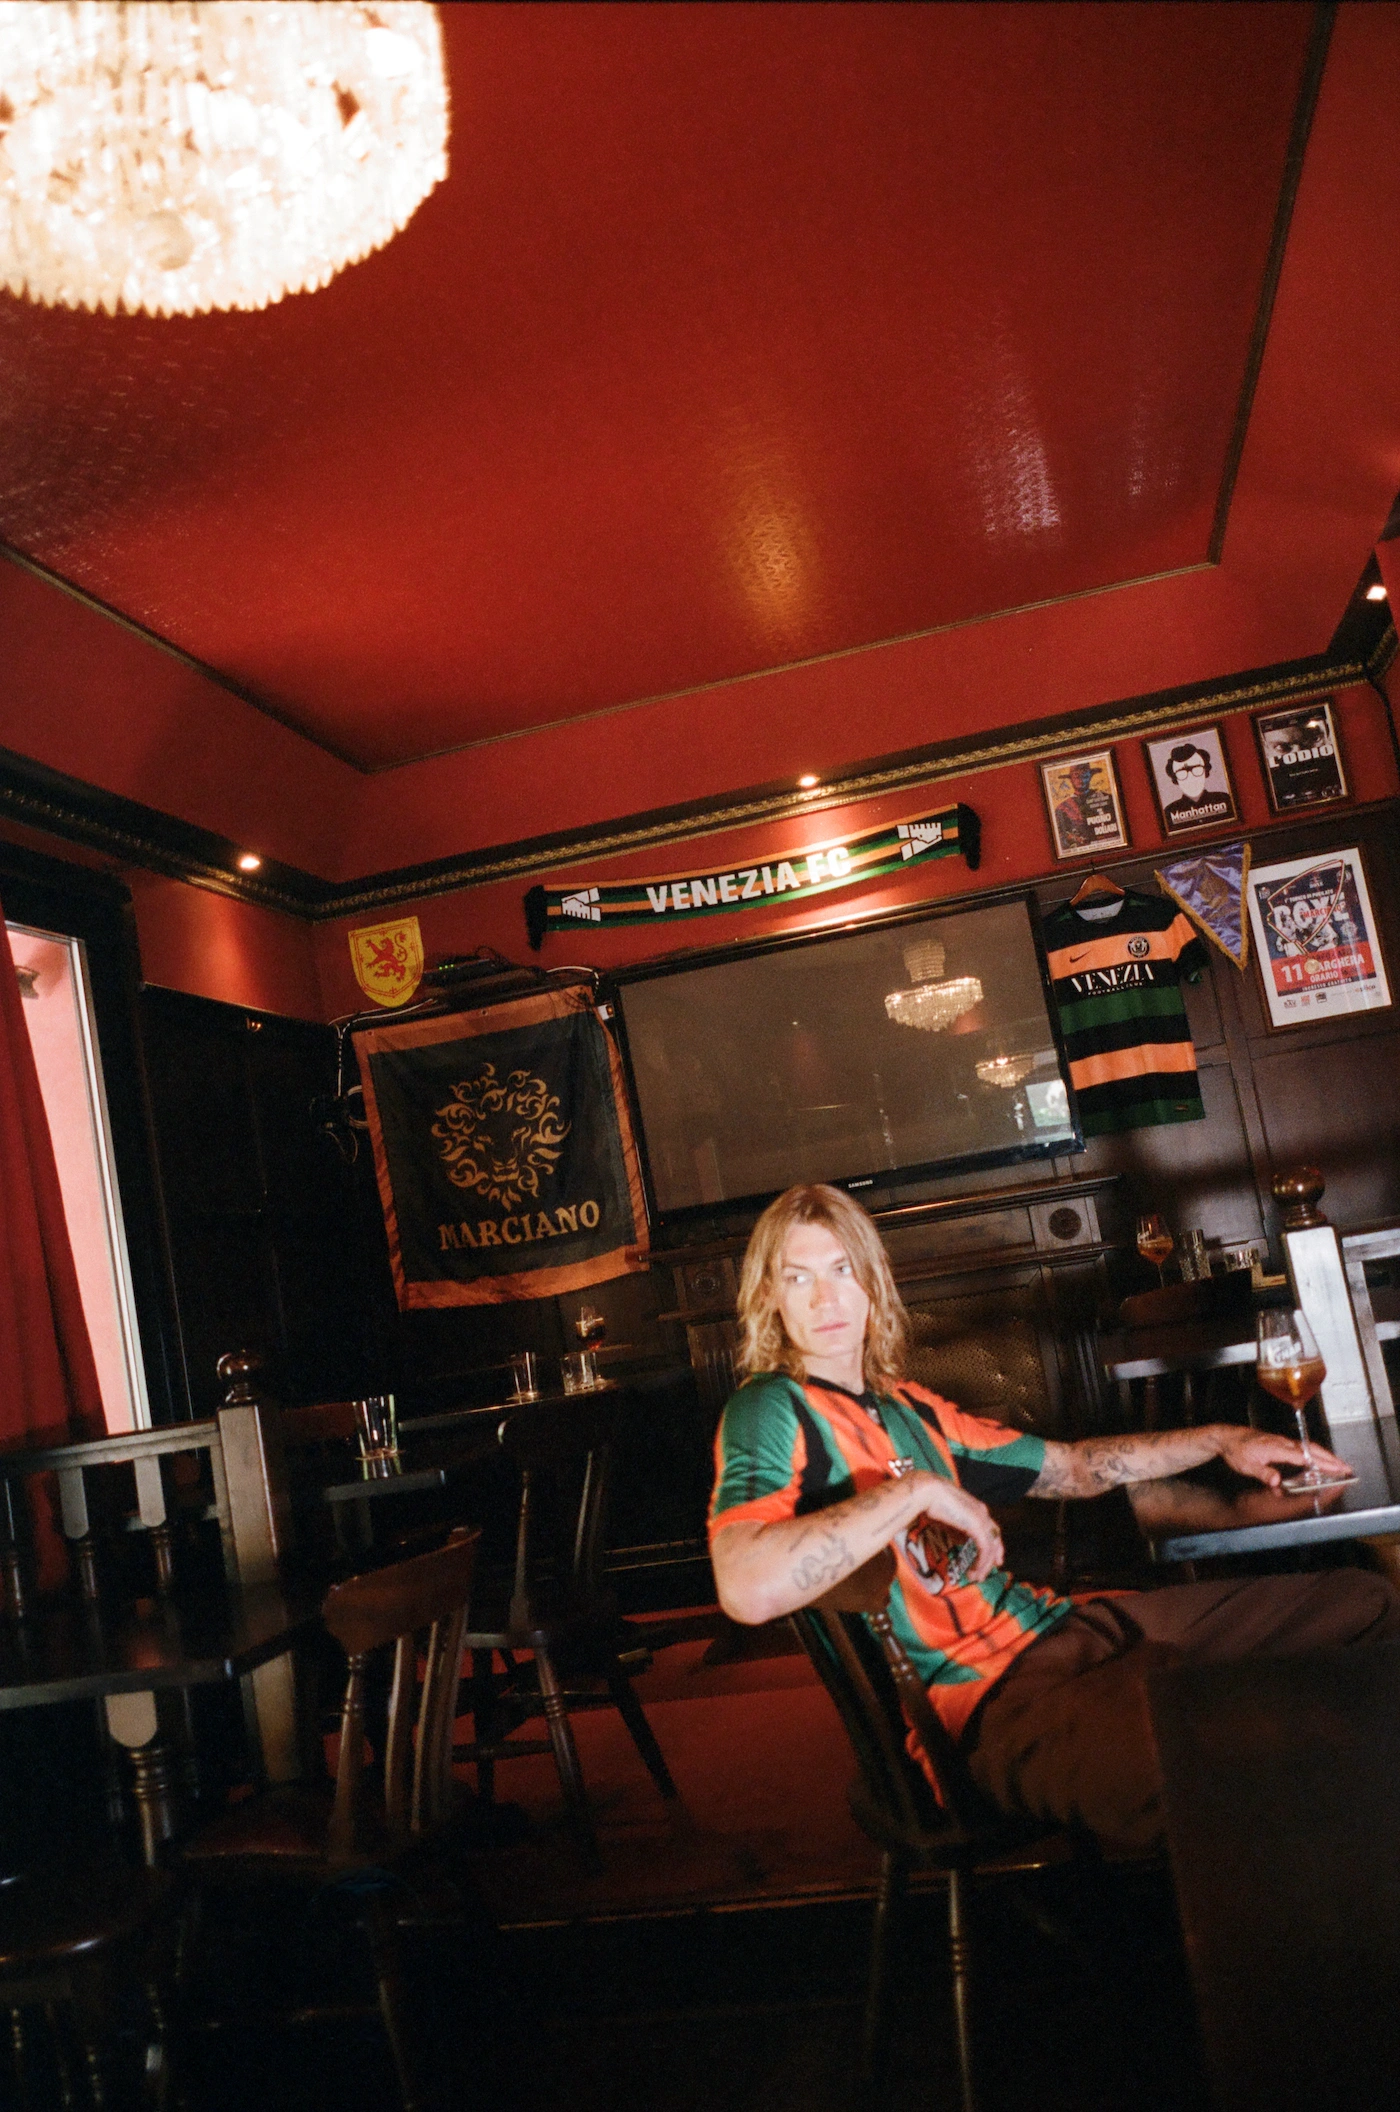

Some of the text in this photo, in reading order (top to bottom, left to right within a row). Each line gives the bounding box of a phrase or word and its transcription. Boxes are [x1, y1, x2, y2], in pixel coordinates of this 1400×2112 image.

[1268, 744, 1334, 768] L'ODIO
[1170, 802, 1227, 821] Manhattan
[646, 847, 851, 913] VENEZIA FC
[1309, 953, 1365, 972] ARGHERA
[1071, 963, 1154, 993] VENEZIA
[1281, 963, 1304, 983] 11
[1309, 971, 1339, 983] ORARIO
[848, 1179, 874, 1189] SAMSUNG
[437, 1200, 600, 1251] MARCIANO
